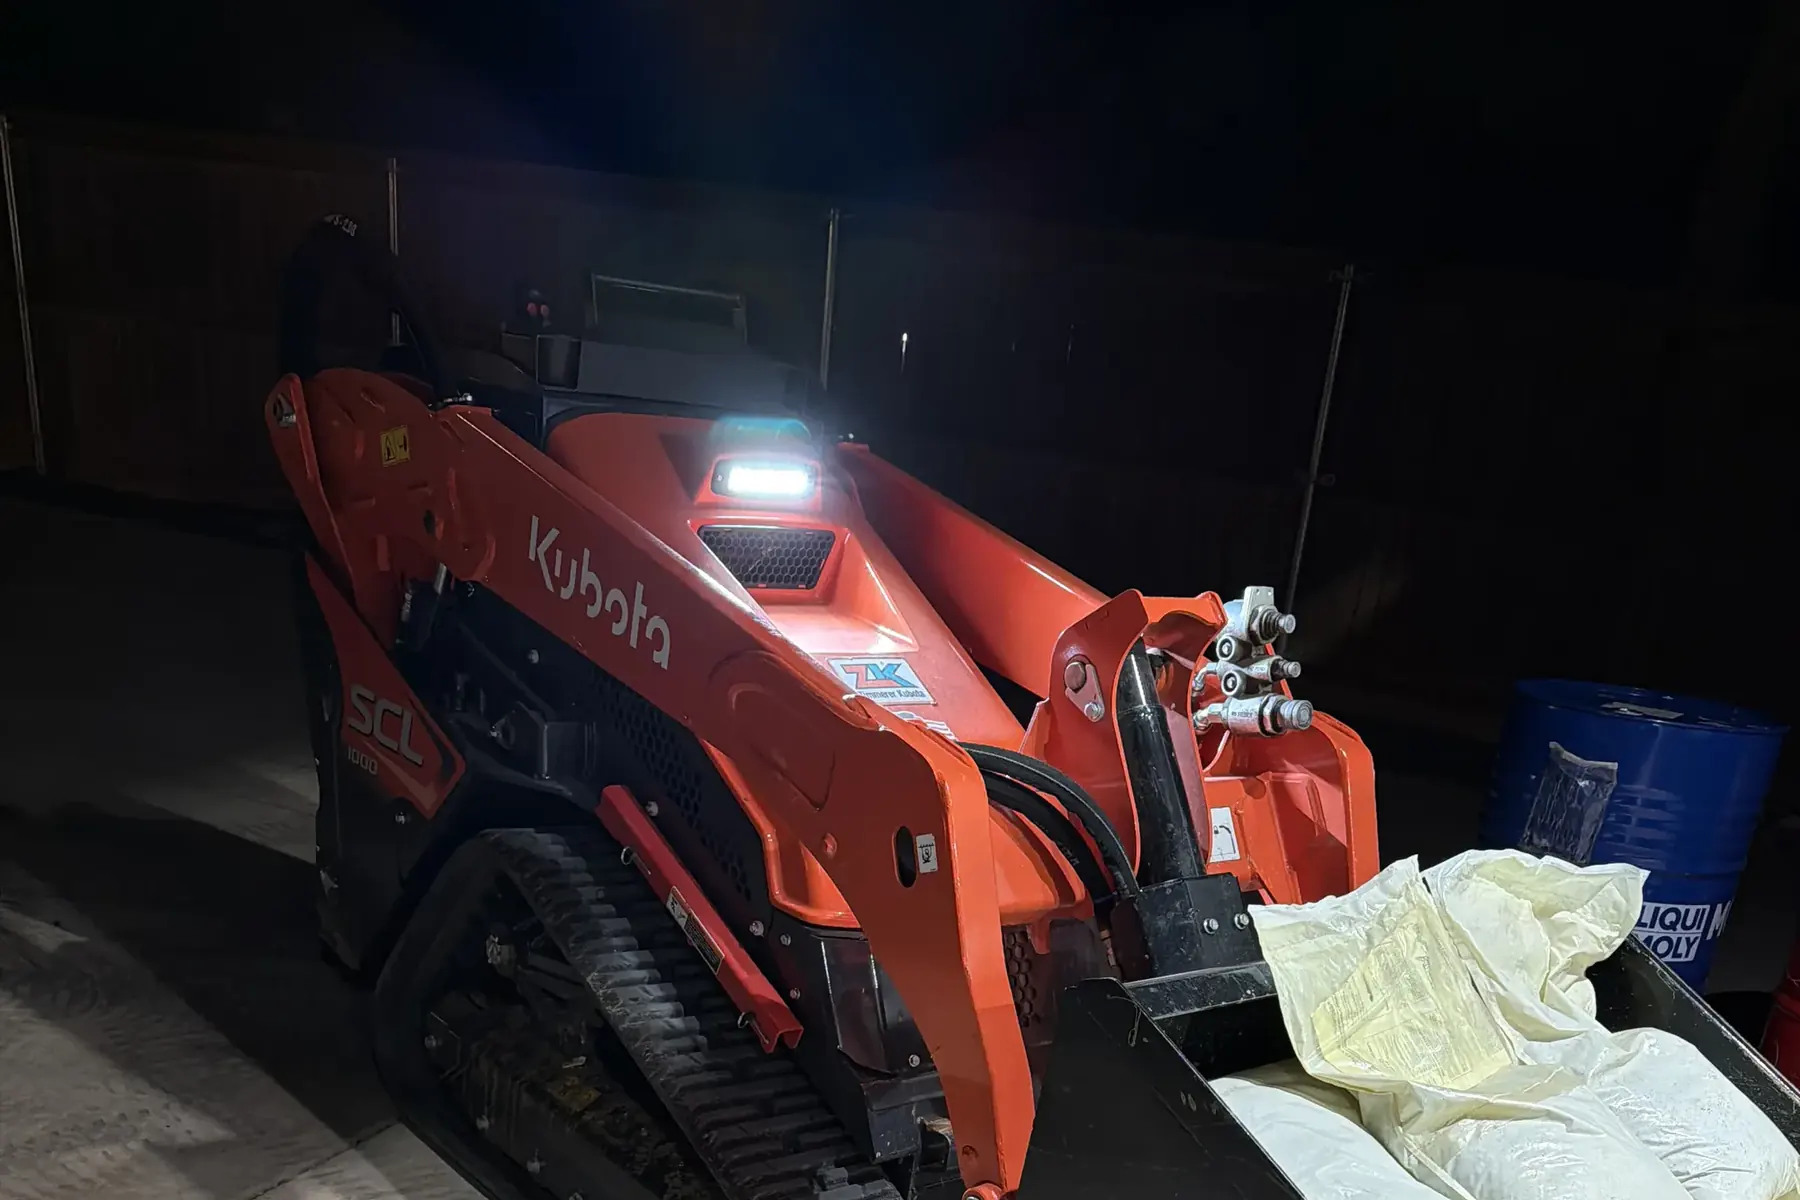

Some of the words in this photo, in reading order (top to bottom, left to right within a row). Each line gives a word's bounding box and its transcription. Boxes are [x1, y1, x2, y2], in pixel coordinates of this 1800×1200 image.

[528, 515, 671, 670] Kubota
[347, 685, 424, 767] SCL
[347, 745, 378, 775] 1000
[1636, 905, 1707, 932] LIQUI
